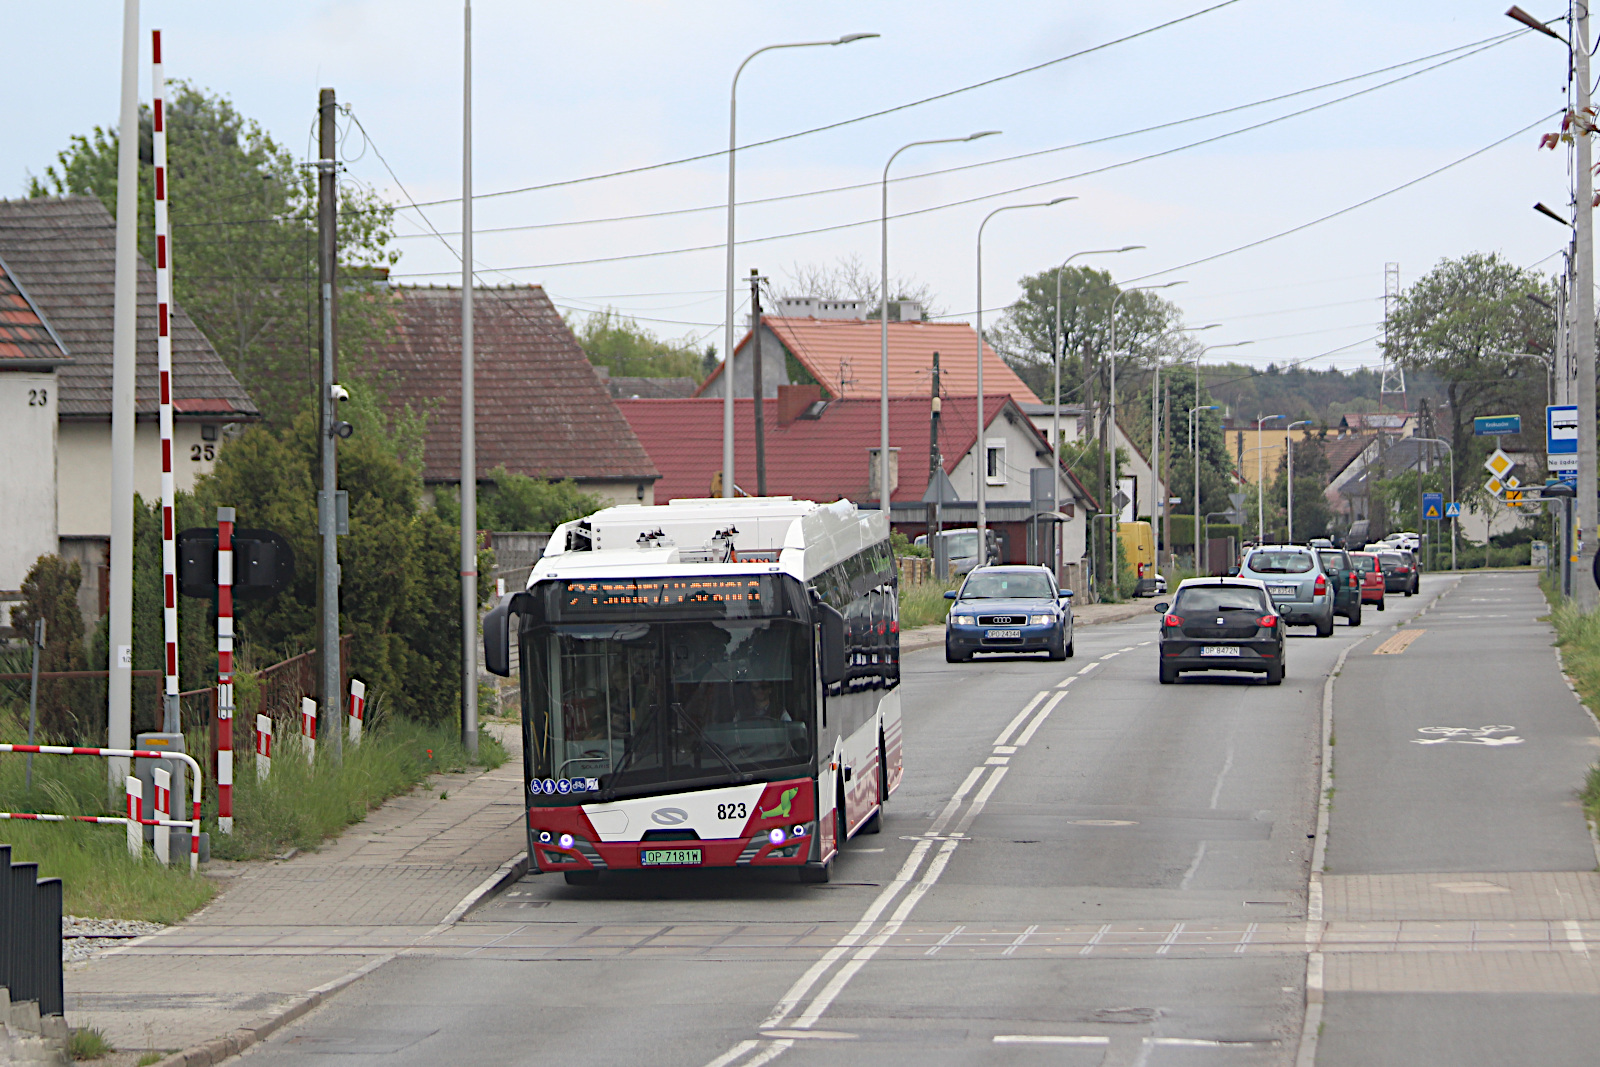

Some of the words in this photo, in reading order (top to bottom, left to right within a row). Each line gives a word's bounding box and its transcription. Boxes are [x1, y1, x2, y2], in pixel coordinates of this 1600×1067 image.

[28, 388, 48, 406] 23
[190, 443, 215, 462] 25
[1205, 646, 1215, 654] OP
[1216, 646, 1239, 654] 8472N
[717, 802, 747, 820] 823
[648, 851, 662, 862] OP
[665, 851, 699, 862] 7181W
